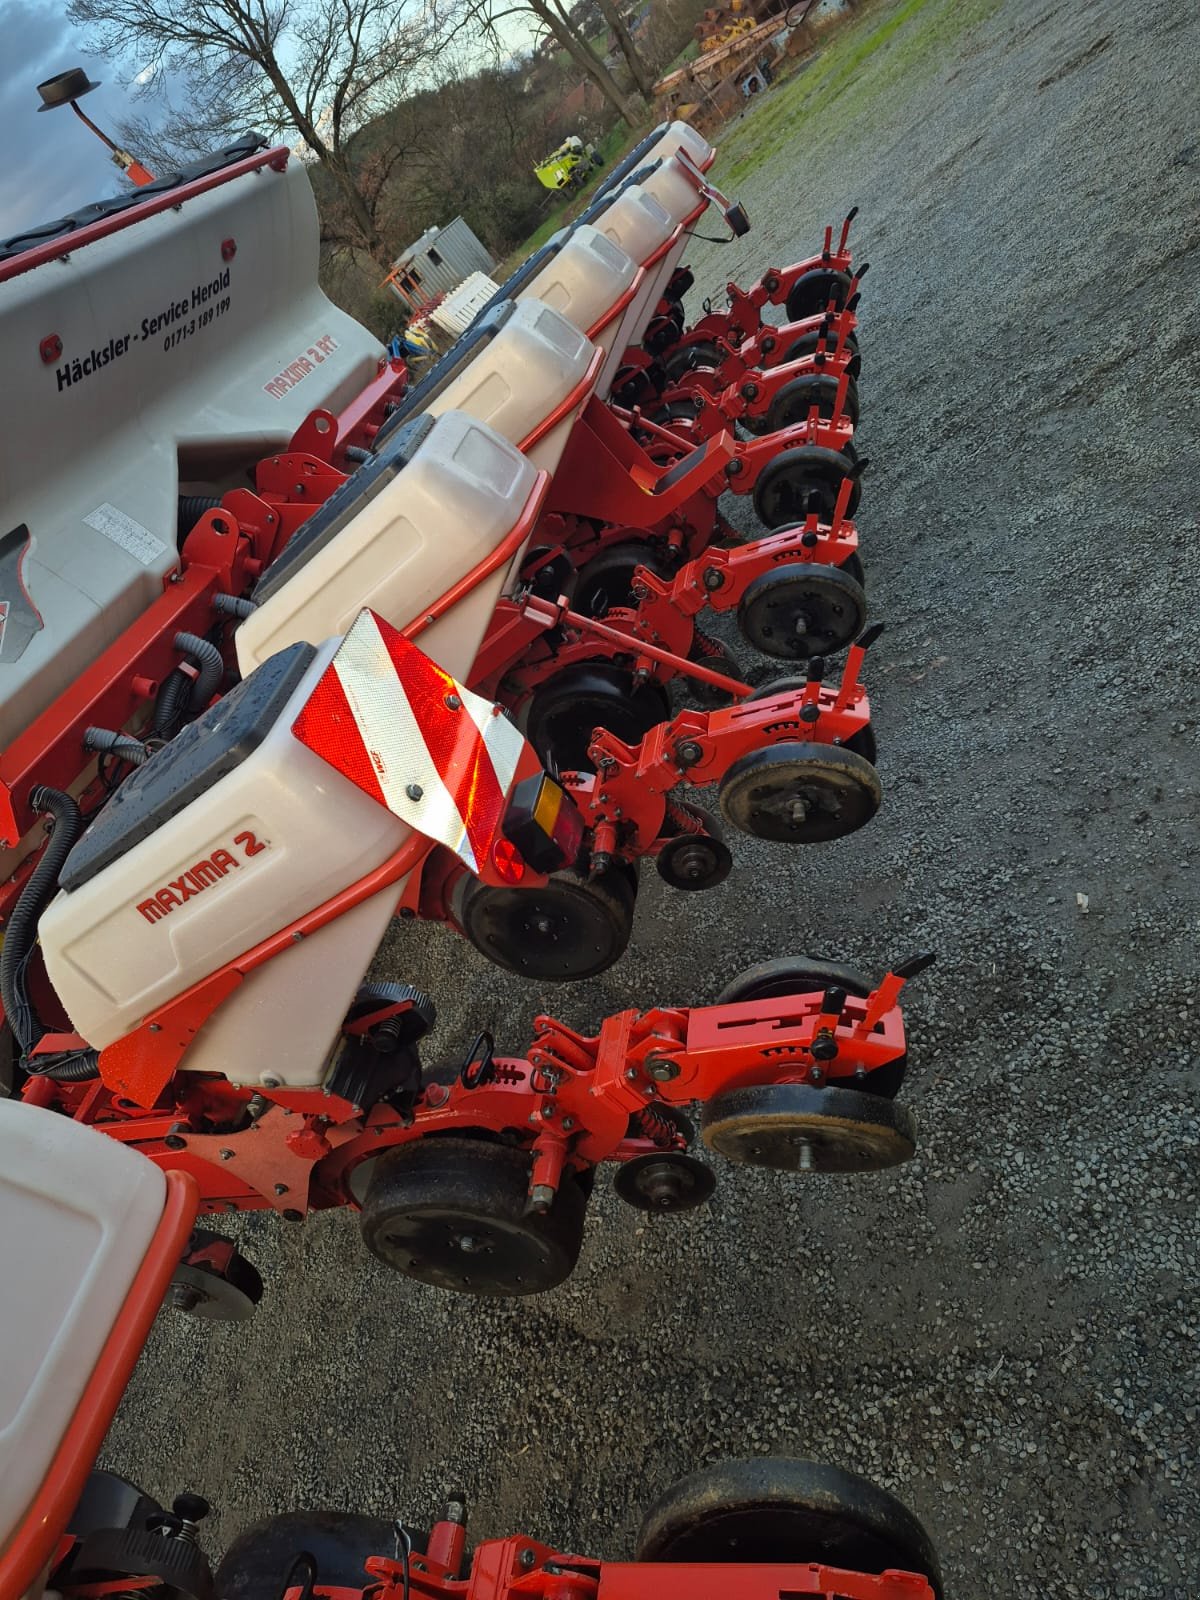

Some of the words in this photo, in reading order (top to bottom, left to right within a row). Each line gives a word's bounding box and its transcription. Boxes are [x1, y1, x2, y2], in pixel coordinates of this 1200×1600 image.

[55, 333, 131, 392] Häcksler
[141, 299, 189, 341] Service
[191, 267, 231, 309] Herold
[163, 320, 196, 352] 0171-3
[198, 307, 214, 330] 189
[216, 297, 231, 318] 199
[263, 356, 316, 400] MAXIMA
[306, 348, 326, 364] 2
[136, 848, 240, 925] MAXIMA
[233, 830, 266, 857] 2
